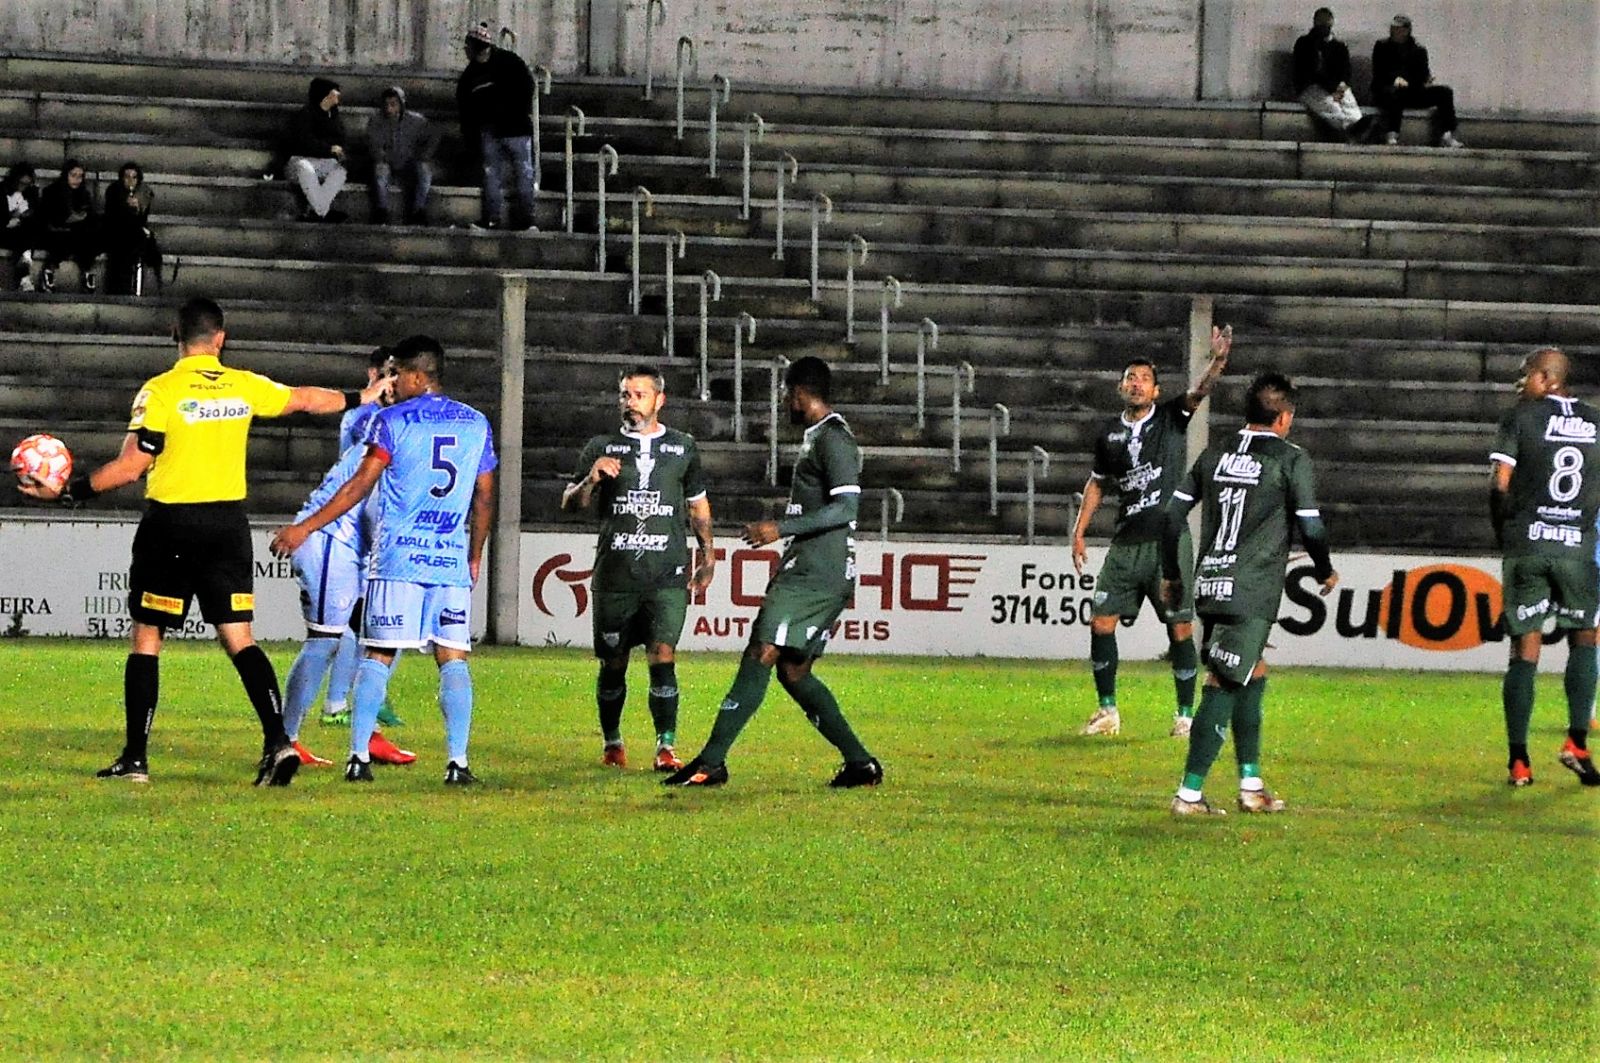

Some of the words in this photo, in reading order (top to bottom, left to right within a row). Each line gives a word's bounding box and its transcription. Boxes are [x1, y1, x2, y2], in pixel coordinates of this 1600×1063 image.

[431, 435, 457, 497] 5
[1549, 446, 1584, 502] 8
[612, 503, 674, 516] TORCEDOR
[1214, 487, 1247, 550] 11
[627, 534, 669, 546] KOPP
[1021, 563, 1094, 591] Fone
[0, 597, 53, 615] EIRA
[370, 614, 404, 627] EVOLVE
